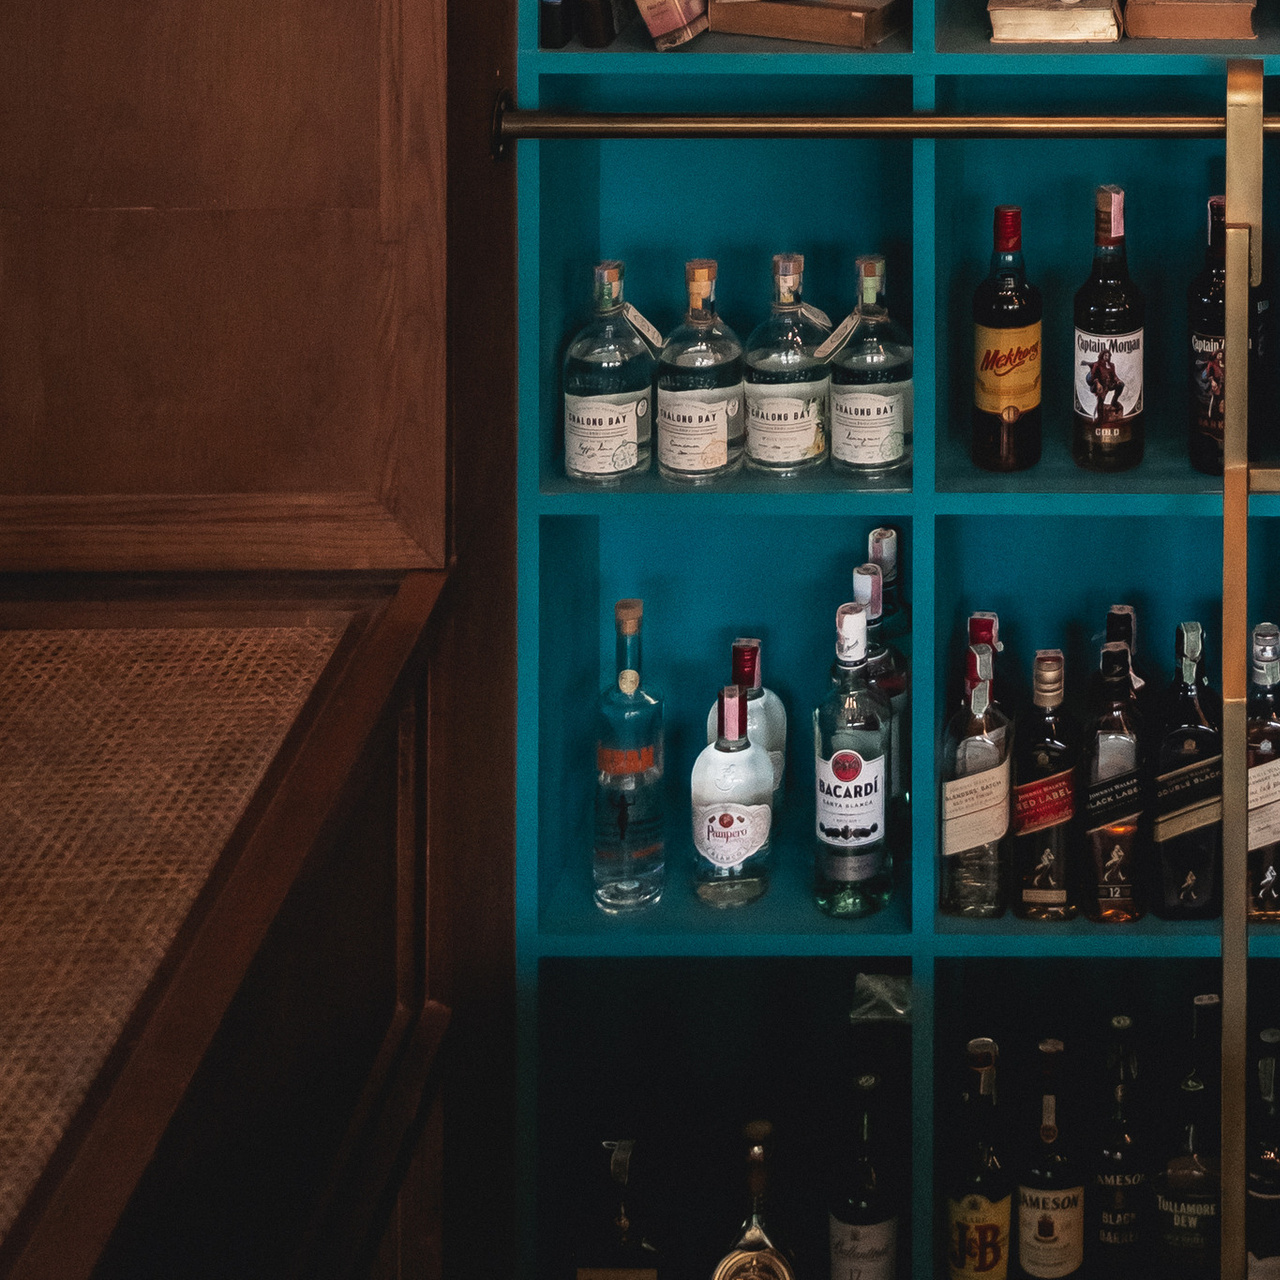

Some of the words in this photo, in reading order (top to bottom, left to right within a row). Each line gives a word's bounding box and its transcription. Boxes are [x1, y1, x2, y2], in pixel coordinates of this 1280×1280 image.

[1076, 334, 1106, 354] Captain
[1108, 336, 1141, 353] Morgan
[1190, 334, 1221, 353] Captain
[751, 408, 788, 423] CHALONG
[793, 409, 812, 421] BAY
[835, 403, 872, 417] CHALONG
[876, 404, 894, 416] BAY
[568, 413, 603, 427] CHALONG
[608, 414, 627, 426] BAY
[697, 414, 717, 424] BAY
[1094, 429, 1120, 437] GOLD
[819, 775, 878, 799] BACARDÍ
[980, 780, 1002, 792] BATCH
[1114, 778, 1138, 791] WALKER
[1156, 779, 1191, 798] DOUBLE
[1193, 771, 1222, 785] BLACK
[1016, 798, 1036, 811] RED
[1038, 788, 1072, 804] LABEL
[707, 824, 747, 843] Pampero
[1109, 883, 1121, 893] 12
[1157, 1194, 1216, 1216] TULLAMORE
[1173, 1214, 1198, 1228] DEW
